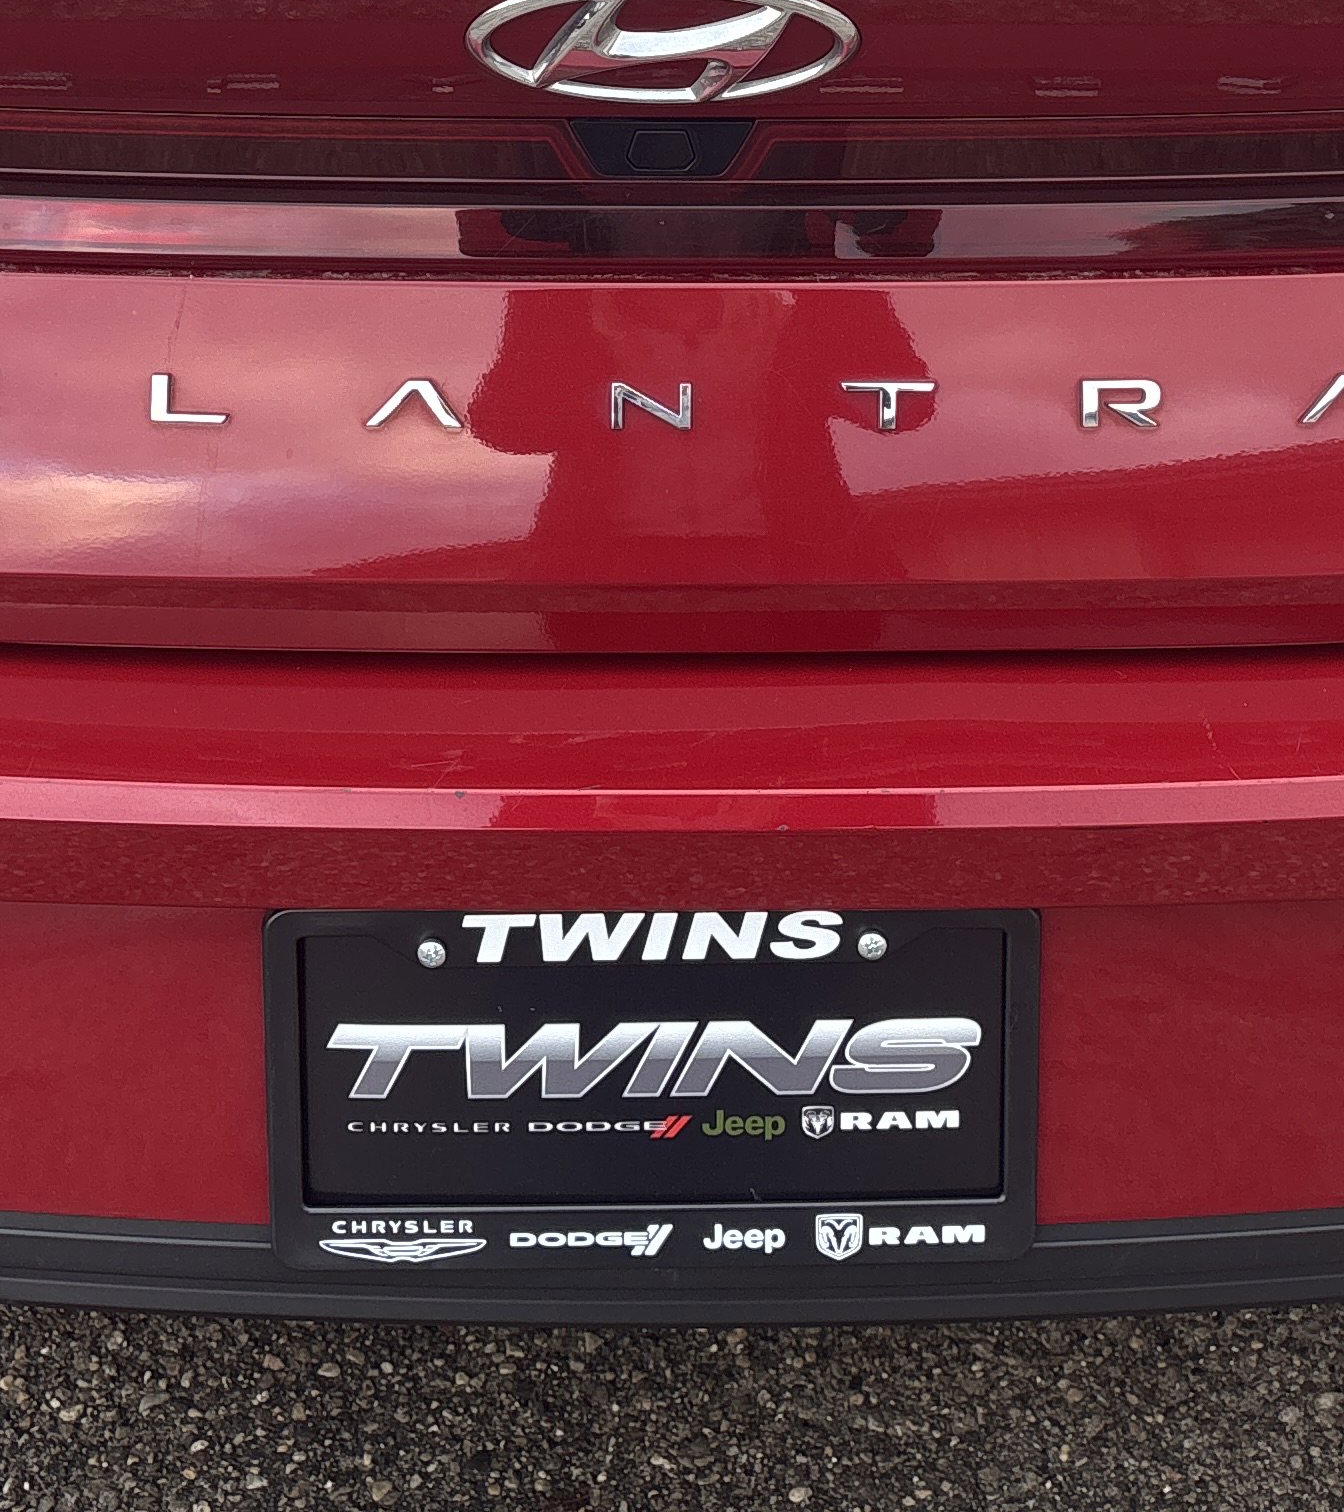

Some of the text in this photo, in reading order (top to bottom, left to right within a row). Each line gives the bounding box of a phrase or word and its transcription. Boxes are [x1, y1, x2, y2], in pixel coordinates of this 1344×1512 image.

[461, 909, 843, 964] TWINS
[326, 1017, 982, 1100] TWINS
[347, 1109, 960, 1141] CHRYSLER DODGE Jeep RAM
[331, 1220, 986, 1254] CHRYSLER DODGE Jeep RAM
